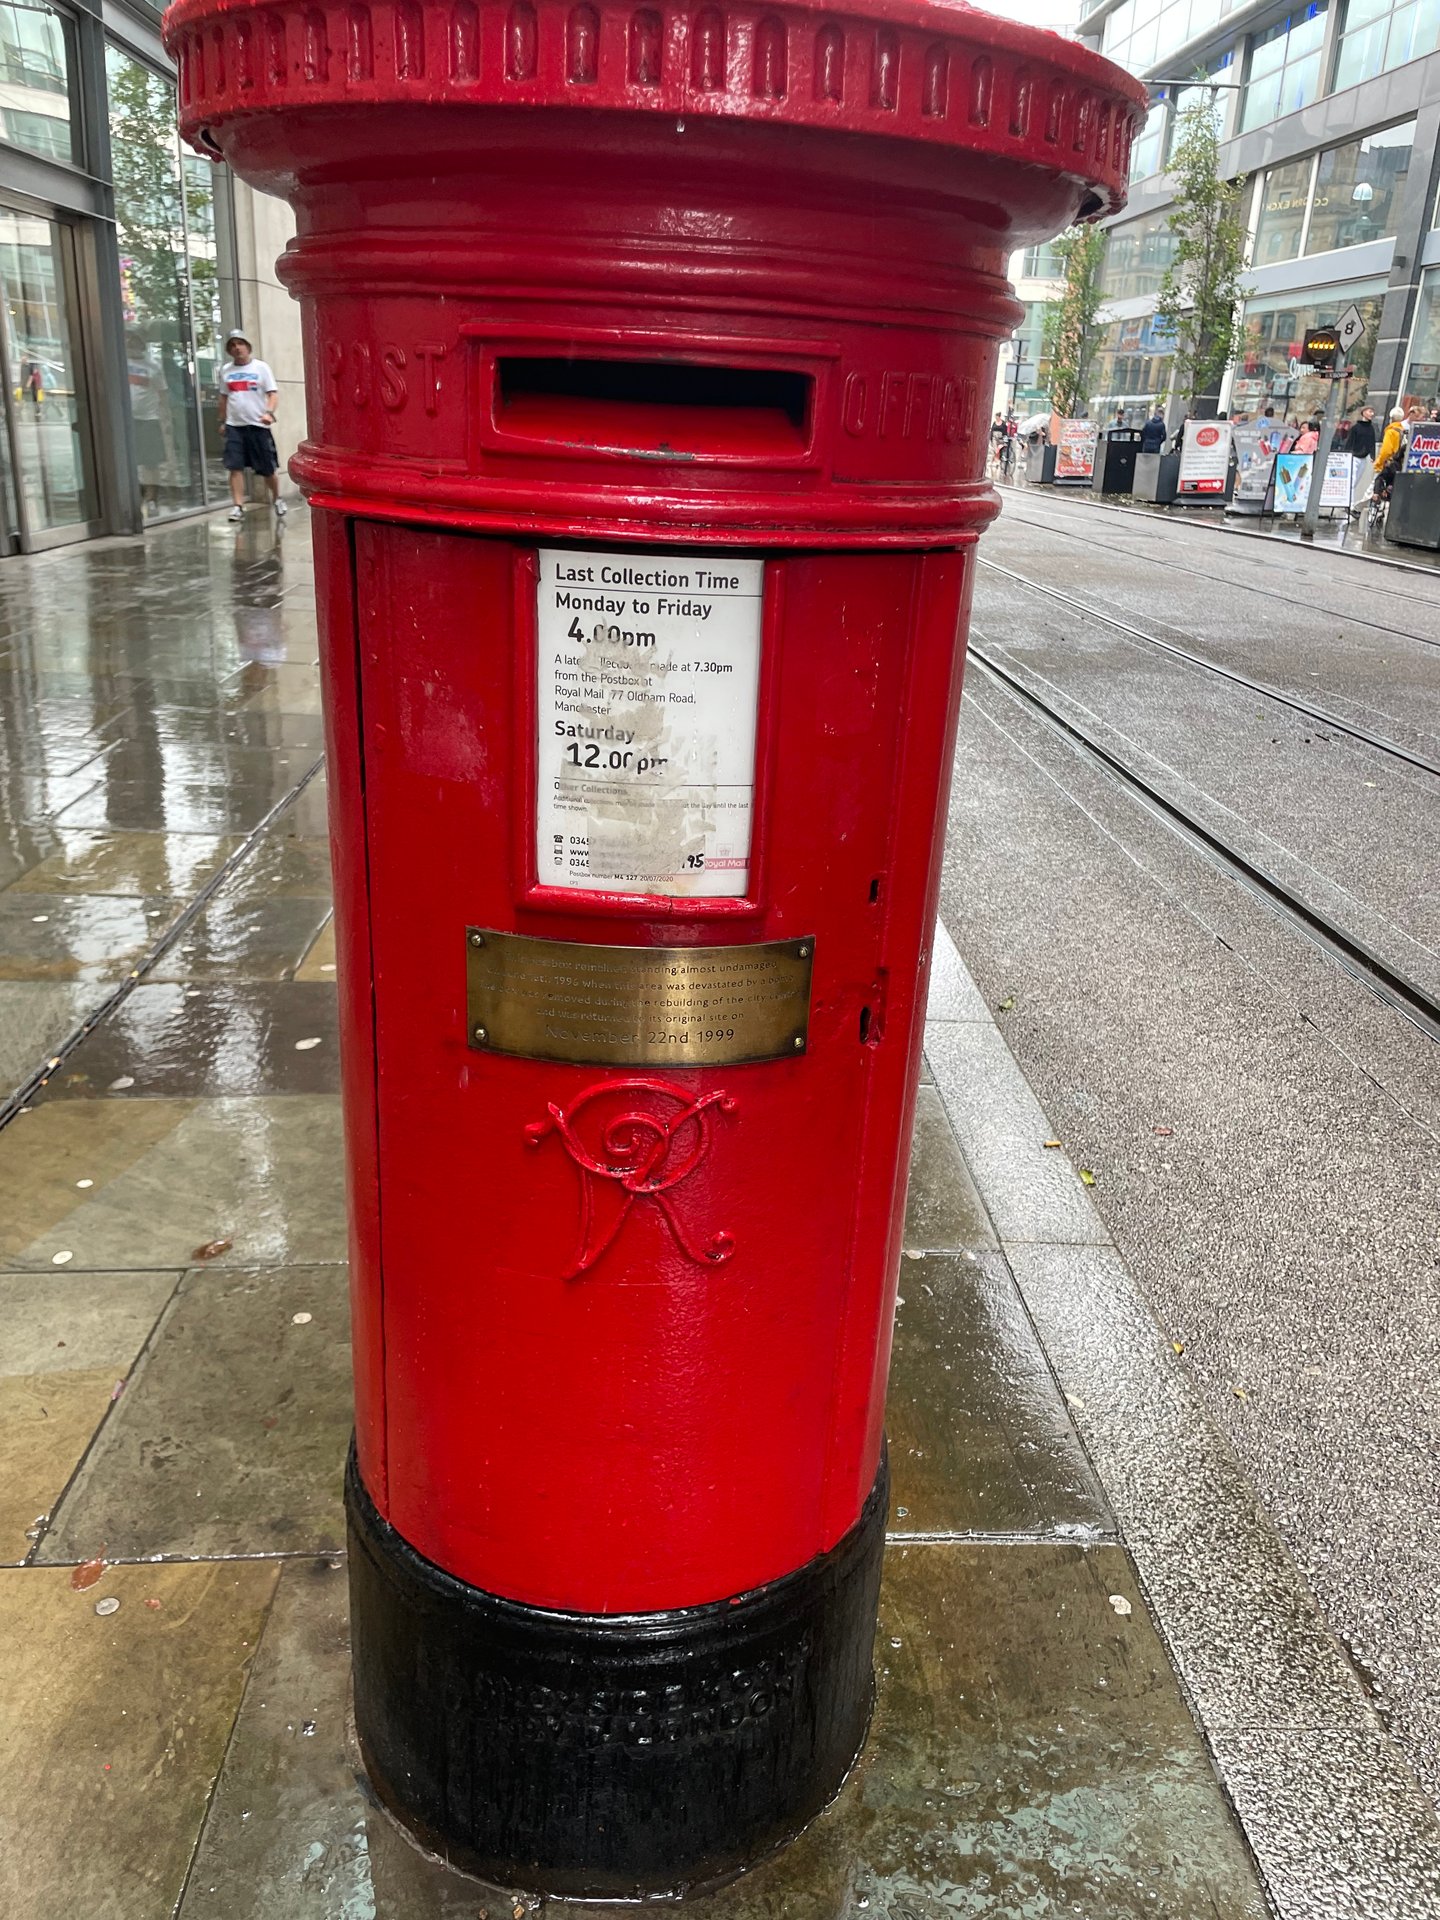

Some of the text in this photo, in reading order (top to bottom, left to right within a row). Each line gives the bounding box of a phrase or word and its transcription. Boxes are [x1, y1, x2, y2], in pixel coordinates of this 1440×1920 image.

[1345, 322, 1354, 335] 8
[322, 335, 447, 418] POST
[841, 369, 978, 446] OFFICE
[555, 563, 740, 590] Last Collection Time
[555, 592, 712, 620] Monday to Friday
[567, 616, 656, 647] 4.00pm
[554, 654, 562, 664] A
[681, 662, 691, 672] at
[694, 661, 733, 675] 7.30pm
[554, 669, 578, 681] from
[581, 672, 597, 683] the
[601, 674, 639, 686] Postbox
[554, 685, 581, 698] Royal
[611, 689, 624, 700] 77
[627, 690, 666, 702] Oldham
[669, 692, 697, 704] Road,
[554, 700, 611, 715] Mancster
[555, 720, 635, 744] Saturday
[728, 859, 746, 868] Mail
[569, 870, 591, 878] Postbox
[552, 958, 571, 969] box
[575, 961, 628, 974] remained
[631, 965, 677, 976] standing
[681, 964, 716, 975] almost
[719, 960, 778, 973] undamaged
[554, 975, 580, 987] 1996
[582, 979, 611, 990] when
[639, 982, 663, 991] area
[666, 982, 686, 991] was
[688, 979, 743, 991] devastated
[746, 977, 758, 988] by
[543, 993, 591, 1005] removed
[654, 996, 709, 1008] rebuilding
[712, 996, 723, 1006] of
[726, 995, 744, 1005] the
[747, 994, 767, 1004] city
[650, 1014, 662, 1023] its
[665, 1013, 706, 1025] original
[709, 1012, 728, 1022] site
[731, 1011, 744, 1021] on
[546, 1024, 735, 1045] November 22nd 1999
